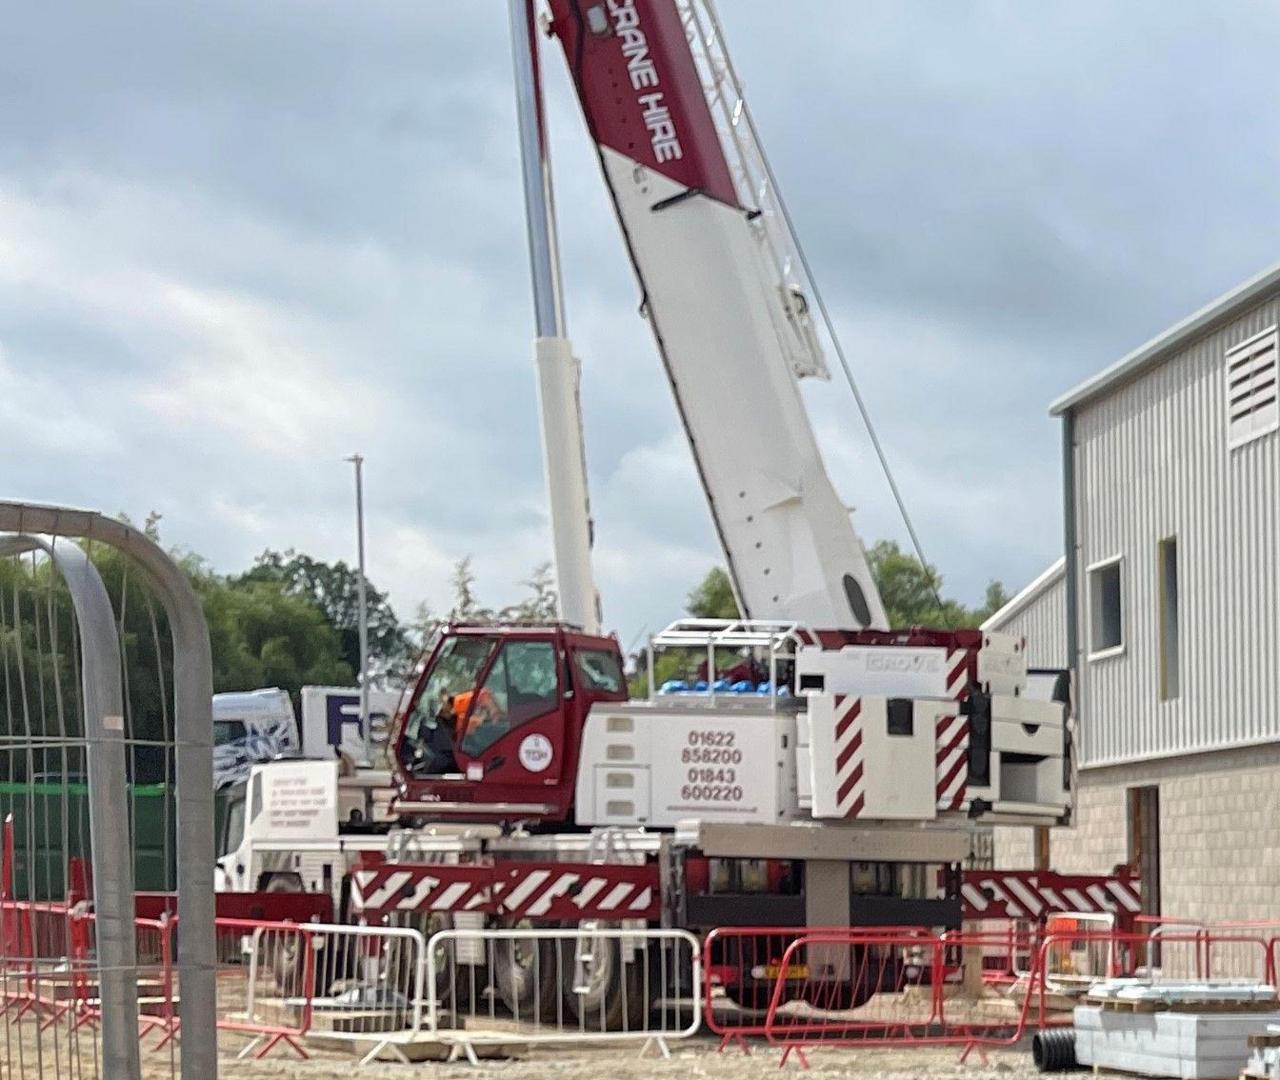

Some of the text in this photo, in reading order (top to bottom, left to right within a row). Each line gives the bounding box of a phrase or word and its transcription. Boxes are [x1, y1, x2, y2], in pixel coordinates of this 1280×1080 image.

[638, 92, 683, 164] HIRE
[688, 730, 736, 747] 01622
[681, 748, 742, 764] 858200
[687, 768, 736, 783] 01843
[681, 785, 743, 801] 600220
